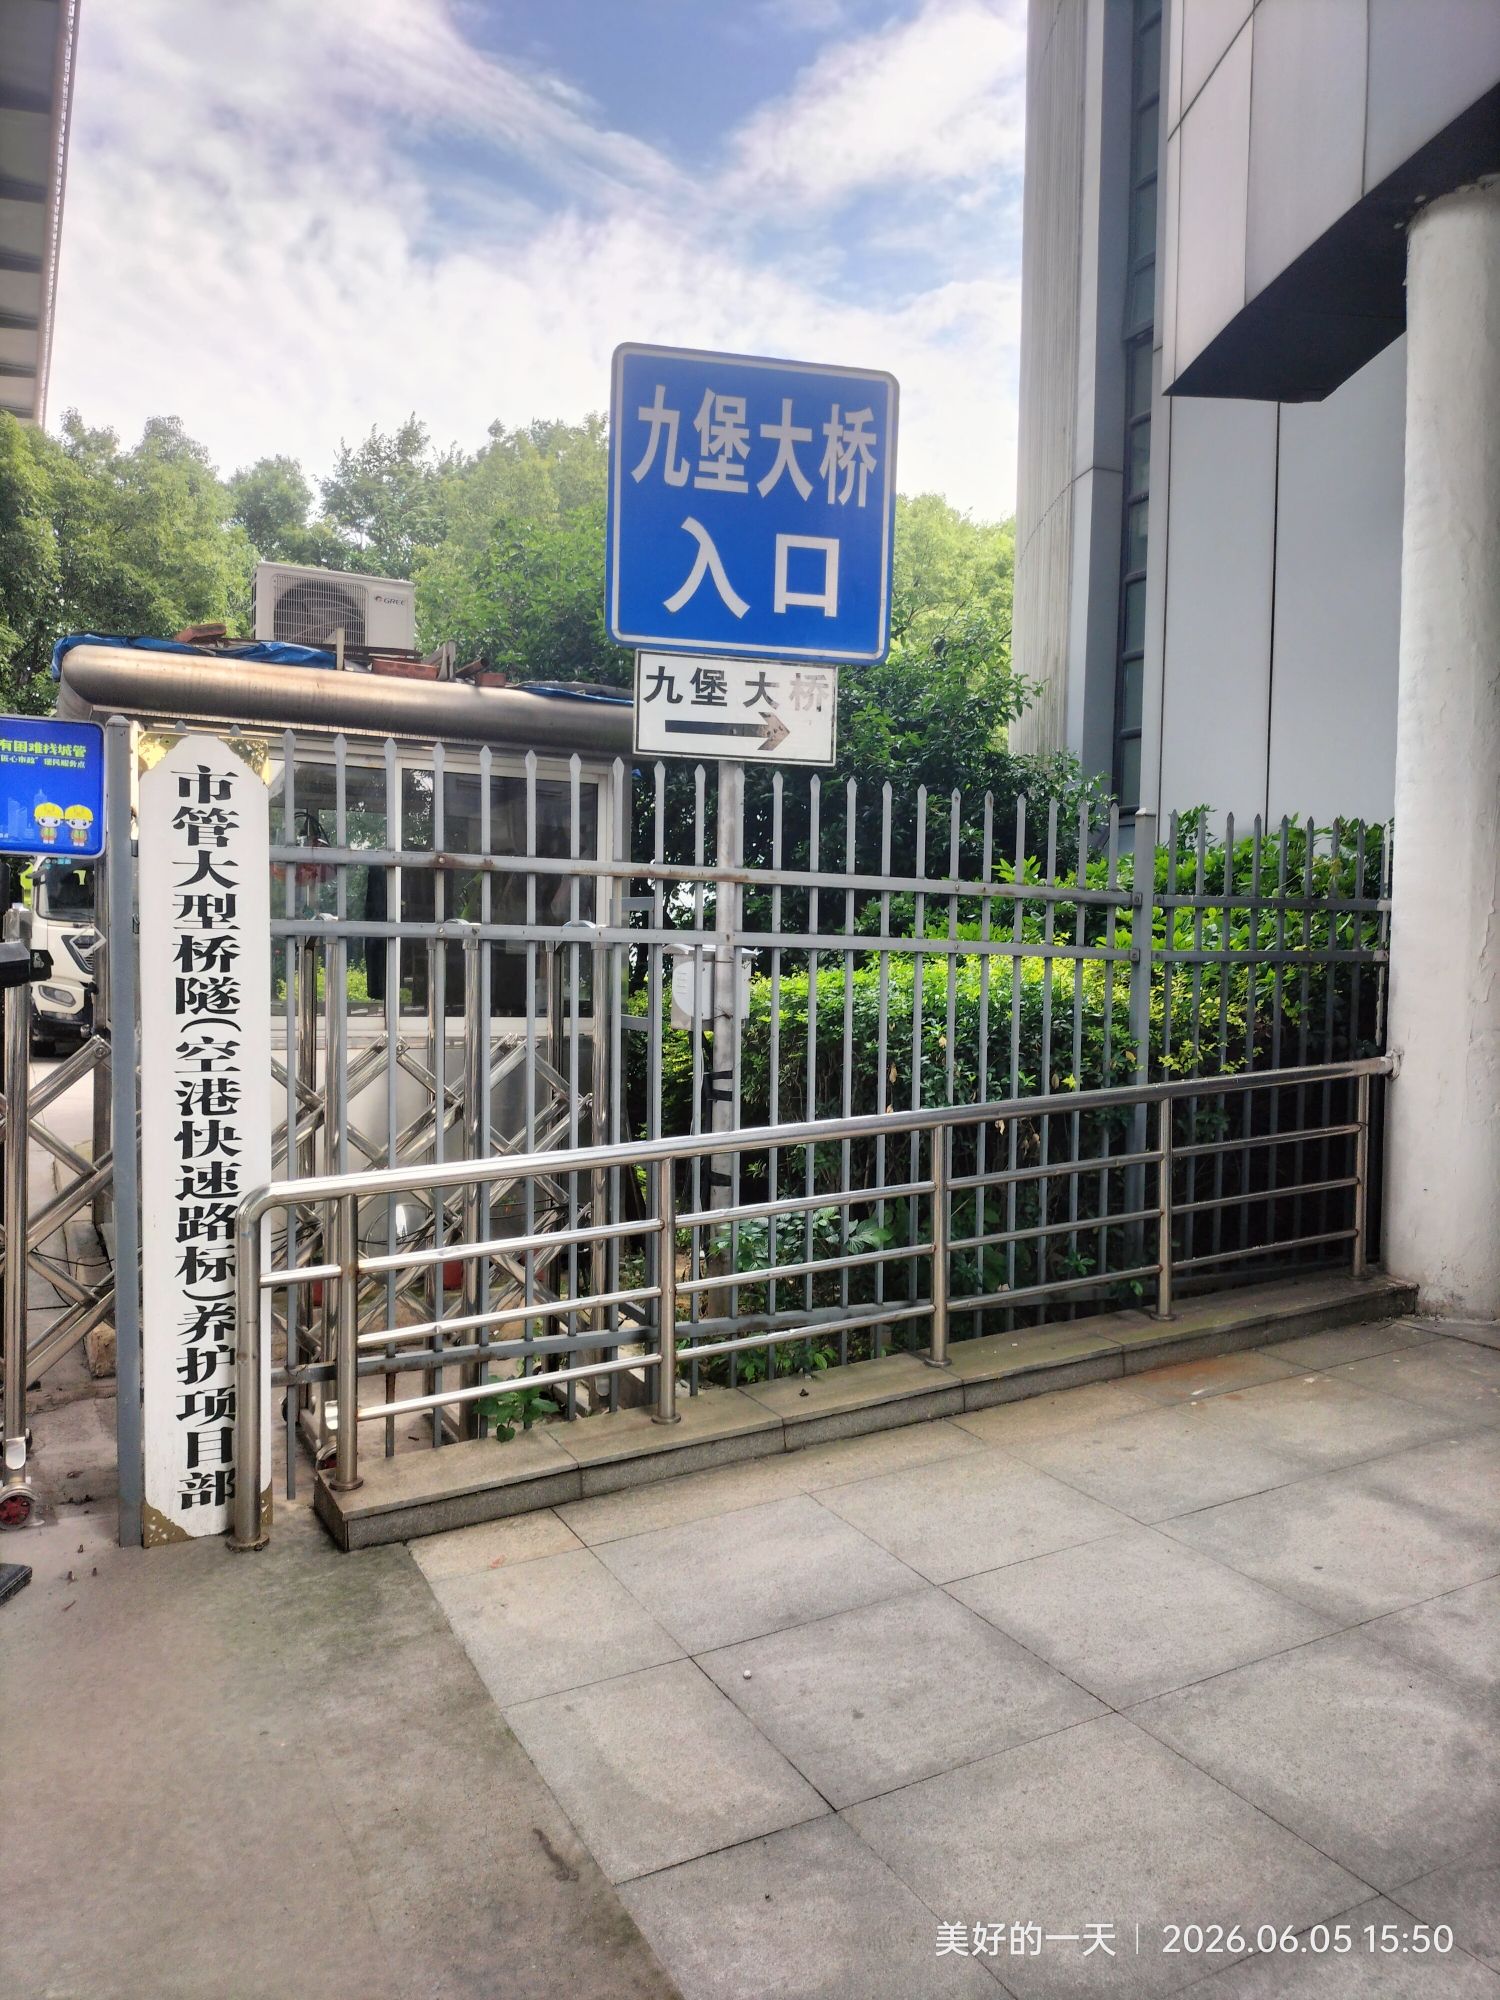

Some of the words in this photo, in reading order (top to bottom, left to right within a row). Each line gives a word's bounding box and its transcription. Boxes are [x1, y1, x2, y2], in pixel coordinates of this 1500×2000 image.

[631, 384, 877, 507] 九堡大桥
[663, 516, 840, 619] 入口
[643, 665, 830, 712] 九堡大桥
[0, 739, 87, 758] 有困难找城管
